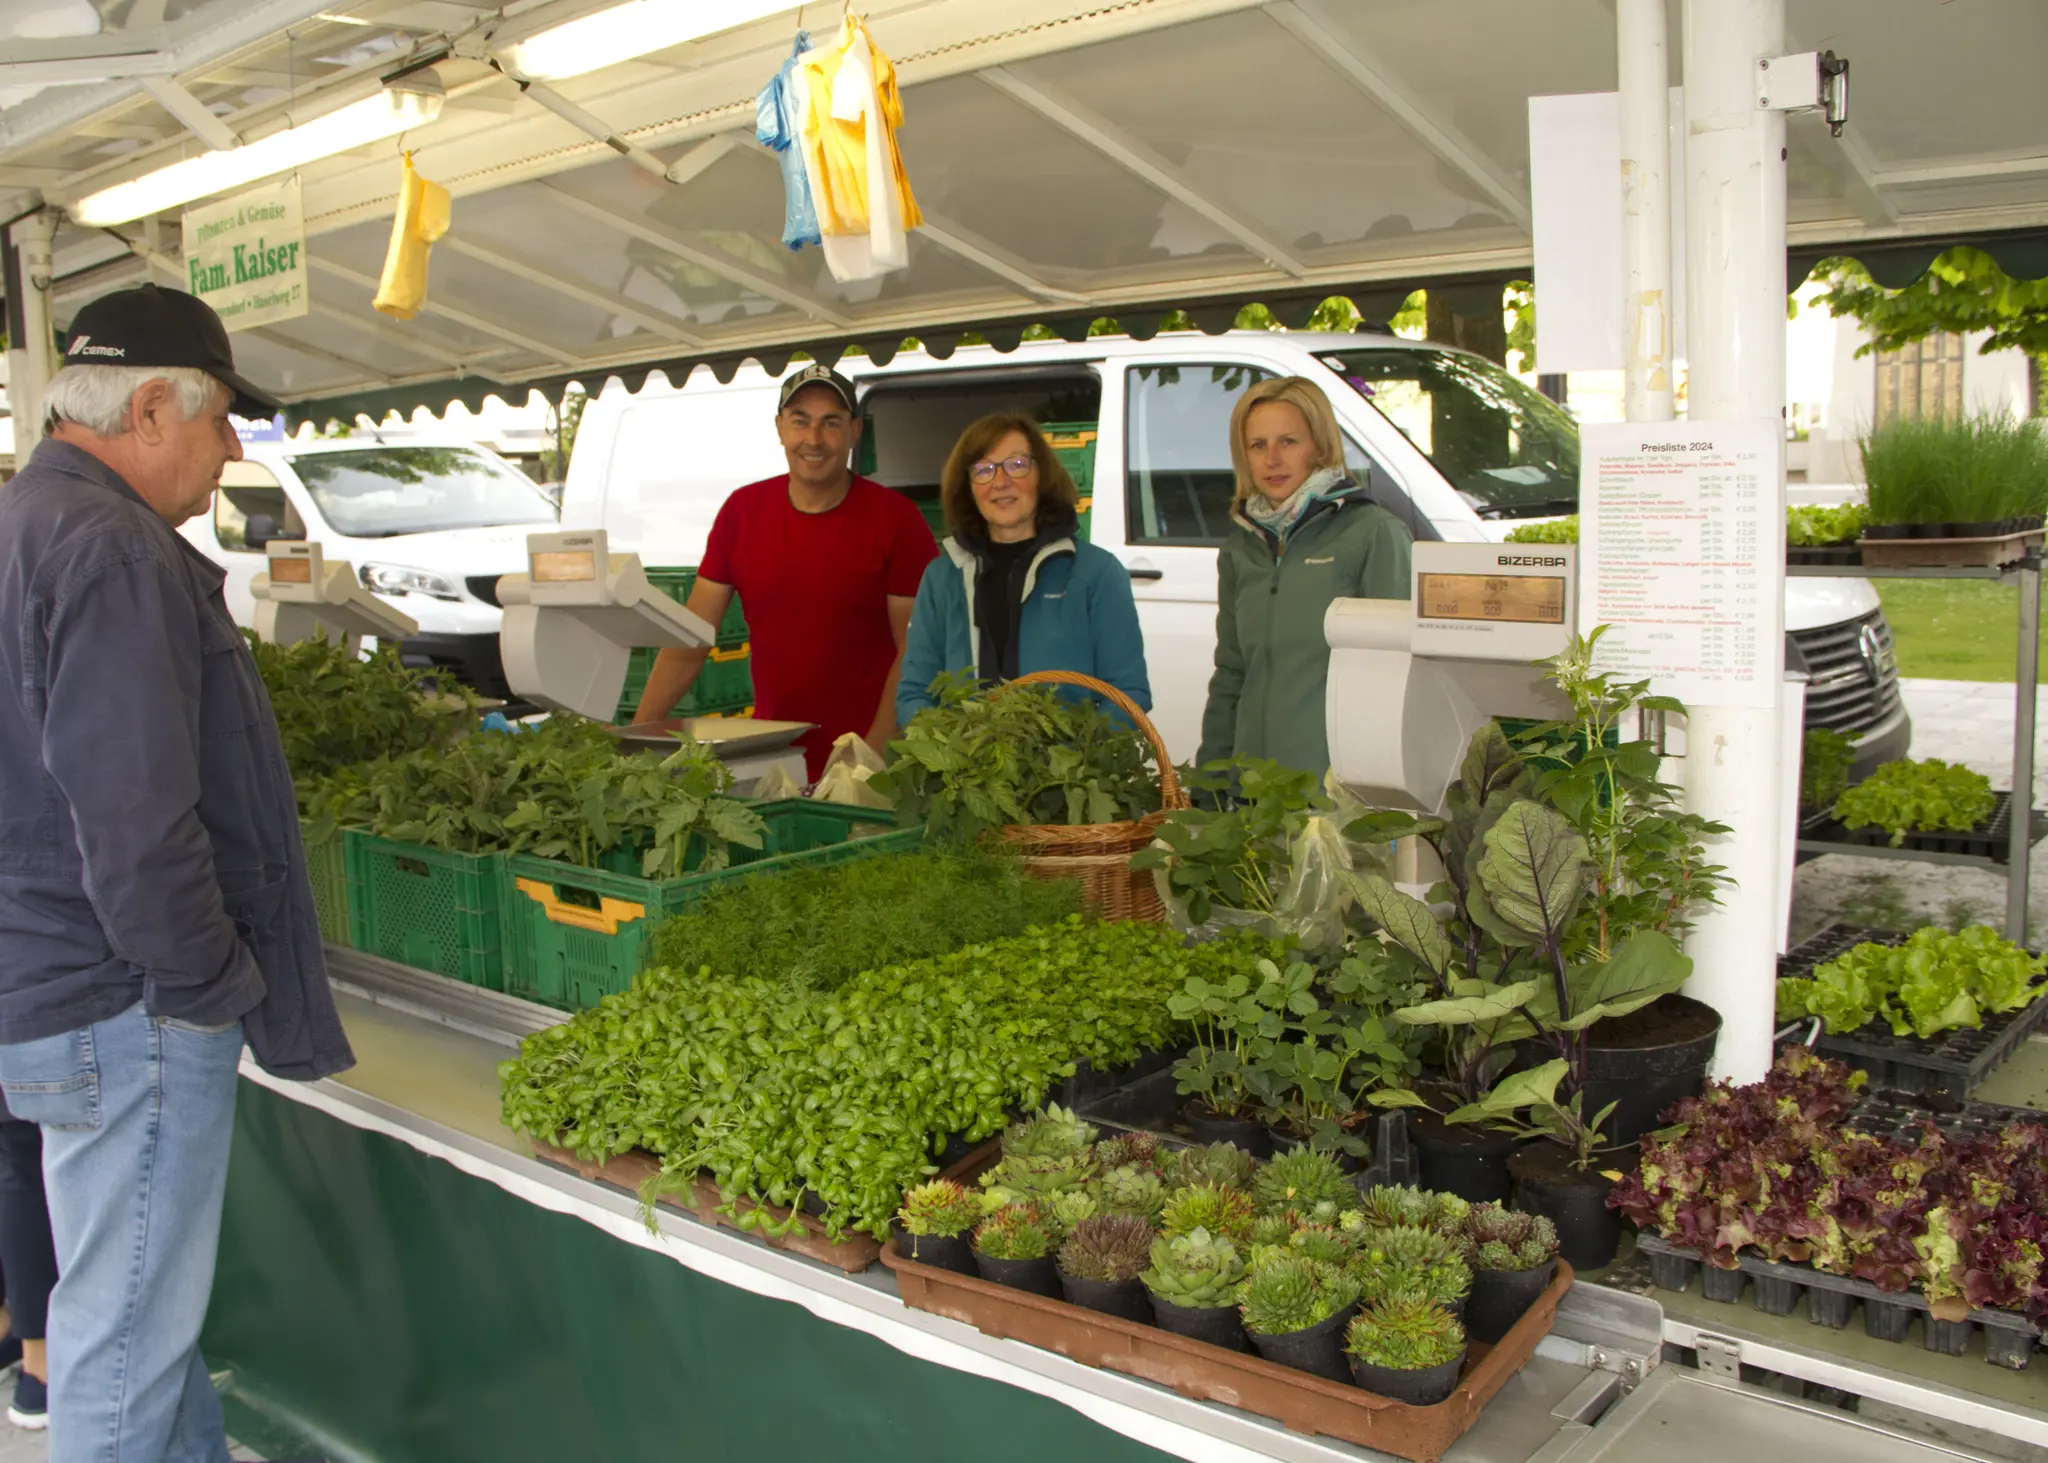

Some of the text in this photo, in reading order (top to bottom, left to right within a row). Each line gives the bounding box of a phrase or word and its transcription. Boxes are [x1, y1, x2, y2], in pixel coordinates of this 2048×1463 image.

[237, 208, 245, 226] &
[247, 202, 286, 223] Gemüse
[189, 238, 299, 296] Fam. Kaiser
[82, 346, 125, 357] CEMEX
[1641, 442, 1713, 453] Preisliste 2024
[1498, 556, 1566, 566] BIZERBA
